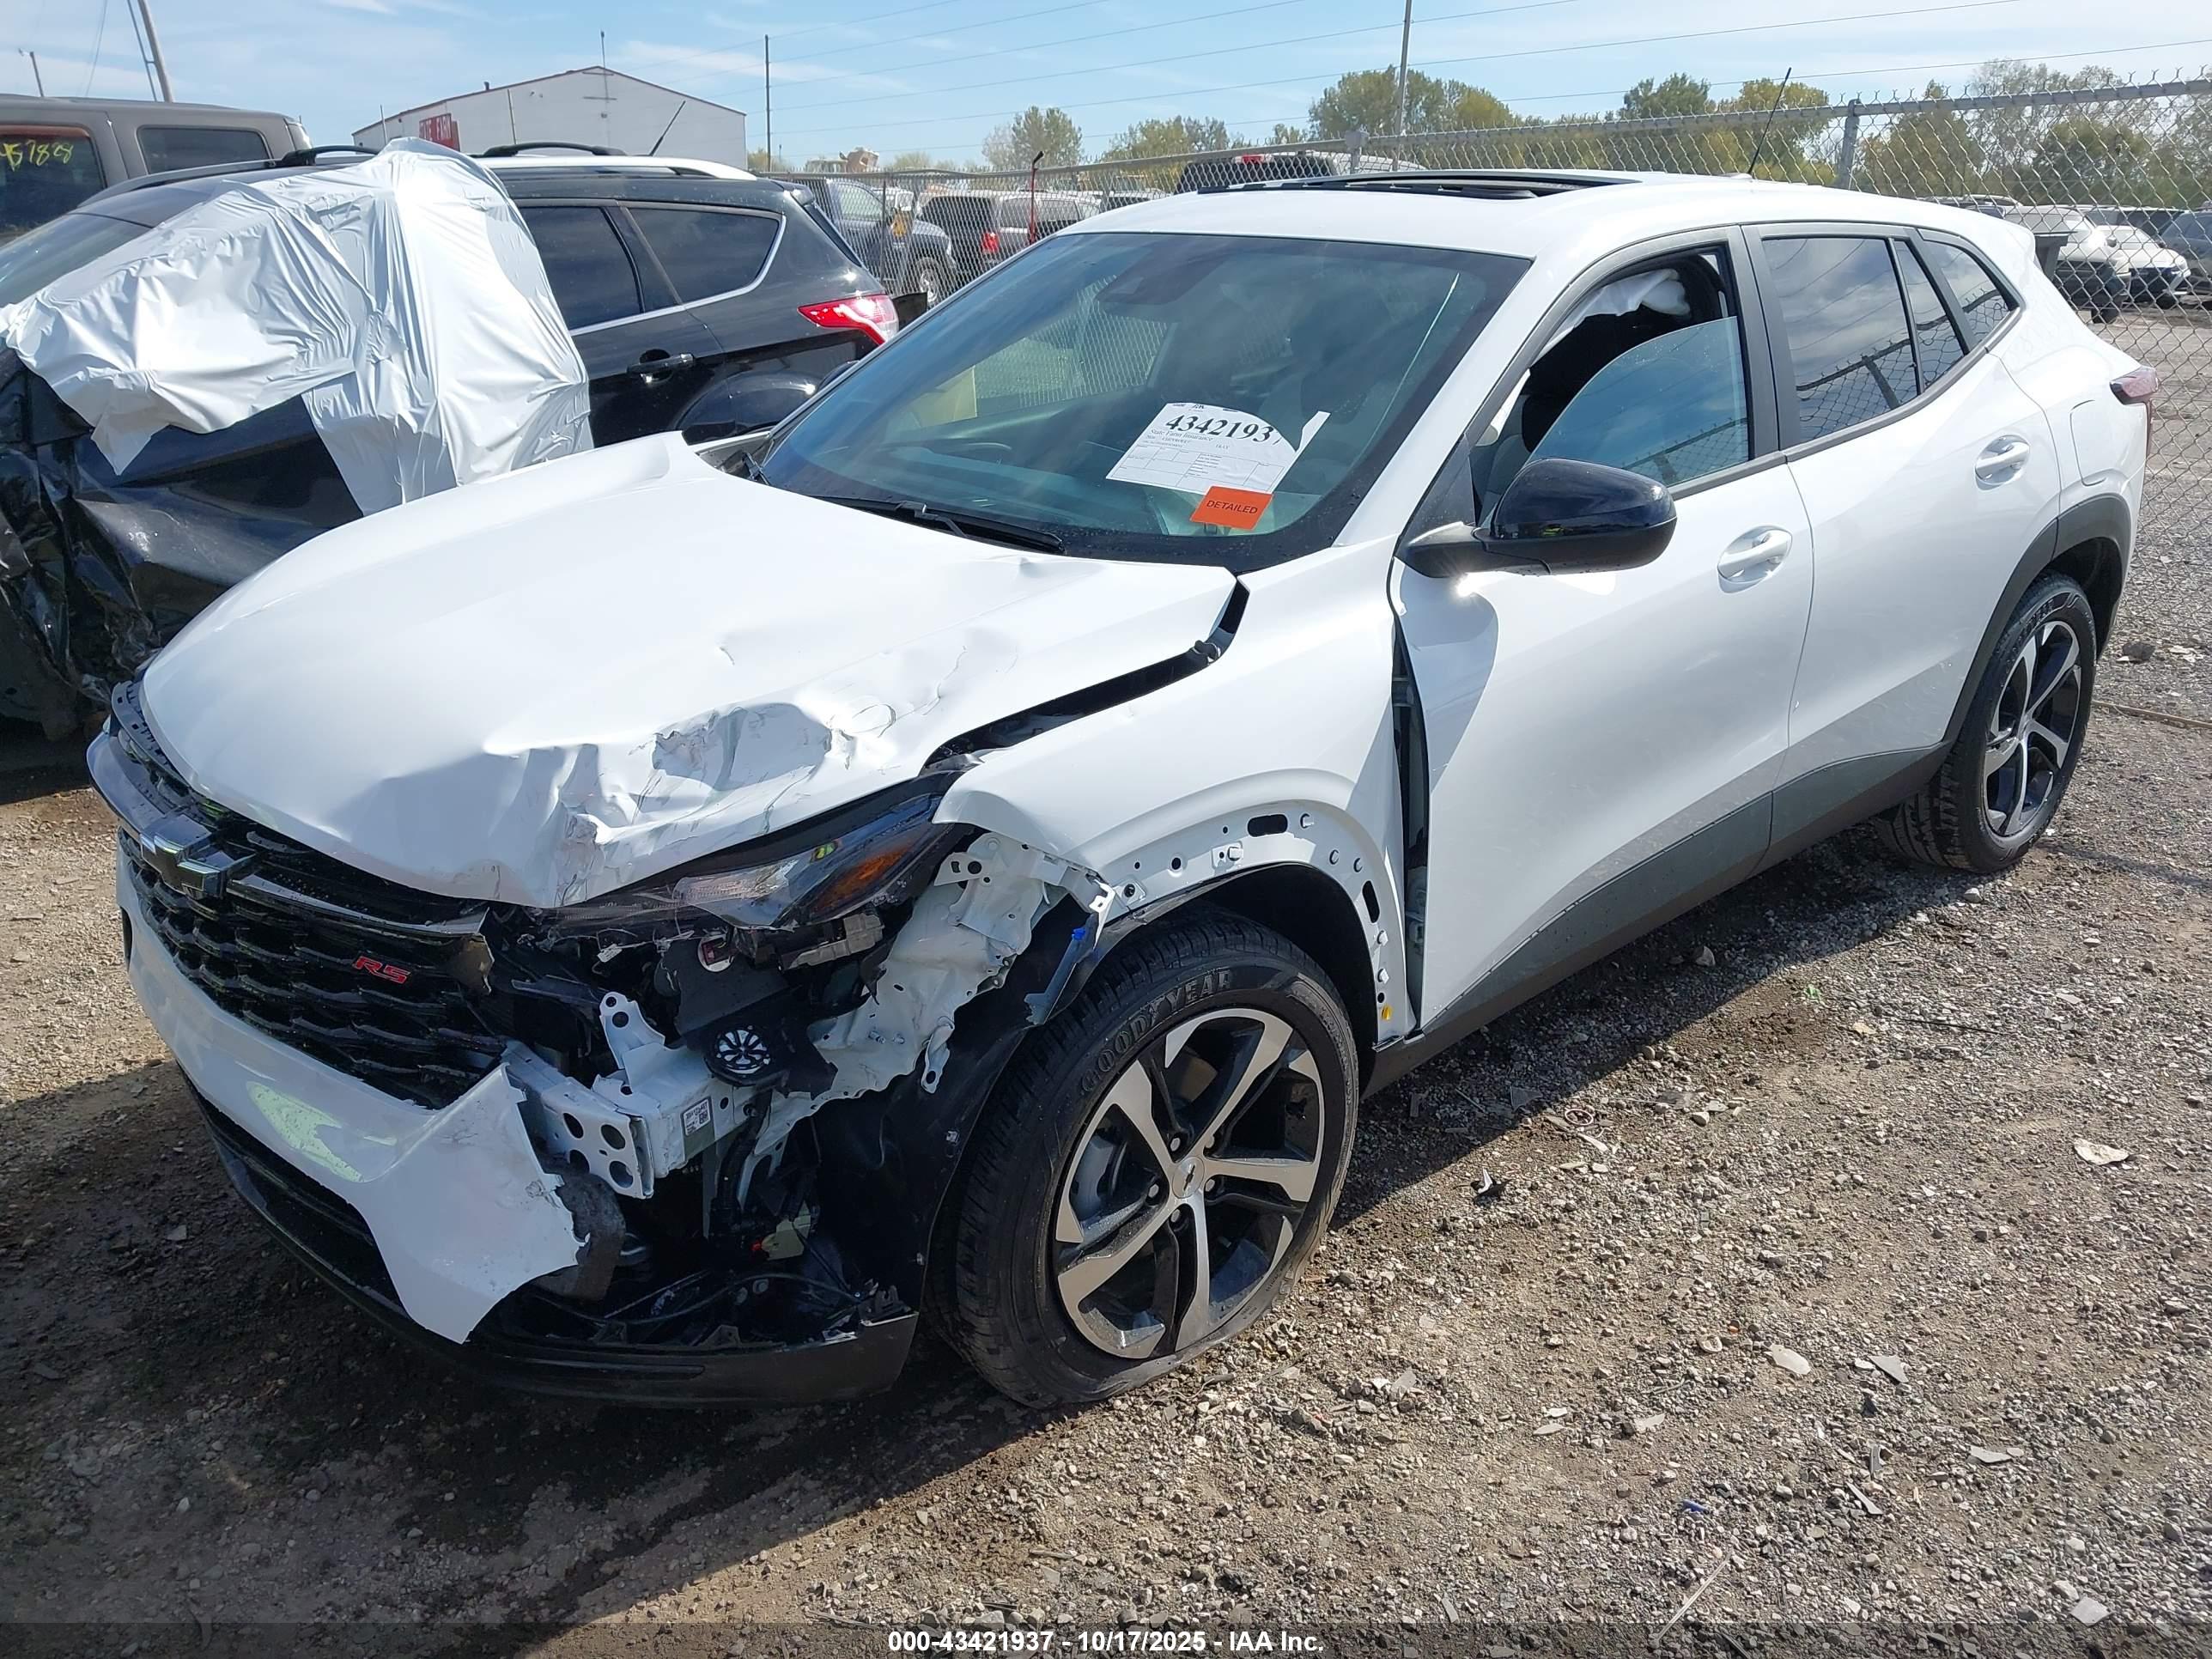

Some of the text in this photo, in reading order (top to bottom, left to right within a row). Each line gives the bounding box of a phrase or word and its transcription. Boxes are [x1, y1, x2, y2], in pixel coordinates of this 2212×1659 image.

[1182, 431, 1214, 441] Insurance
[1206, 500, 1258, 514] DETAILED
[352, 956, 412, 984] RS
[1081, 970, 1231, 1091] GOODYEAR
